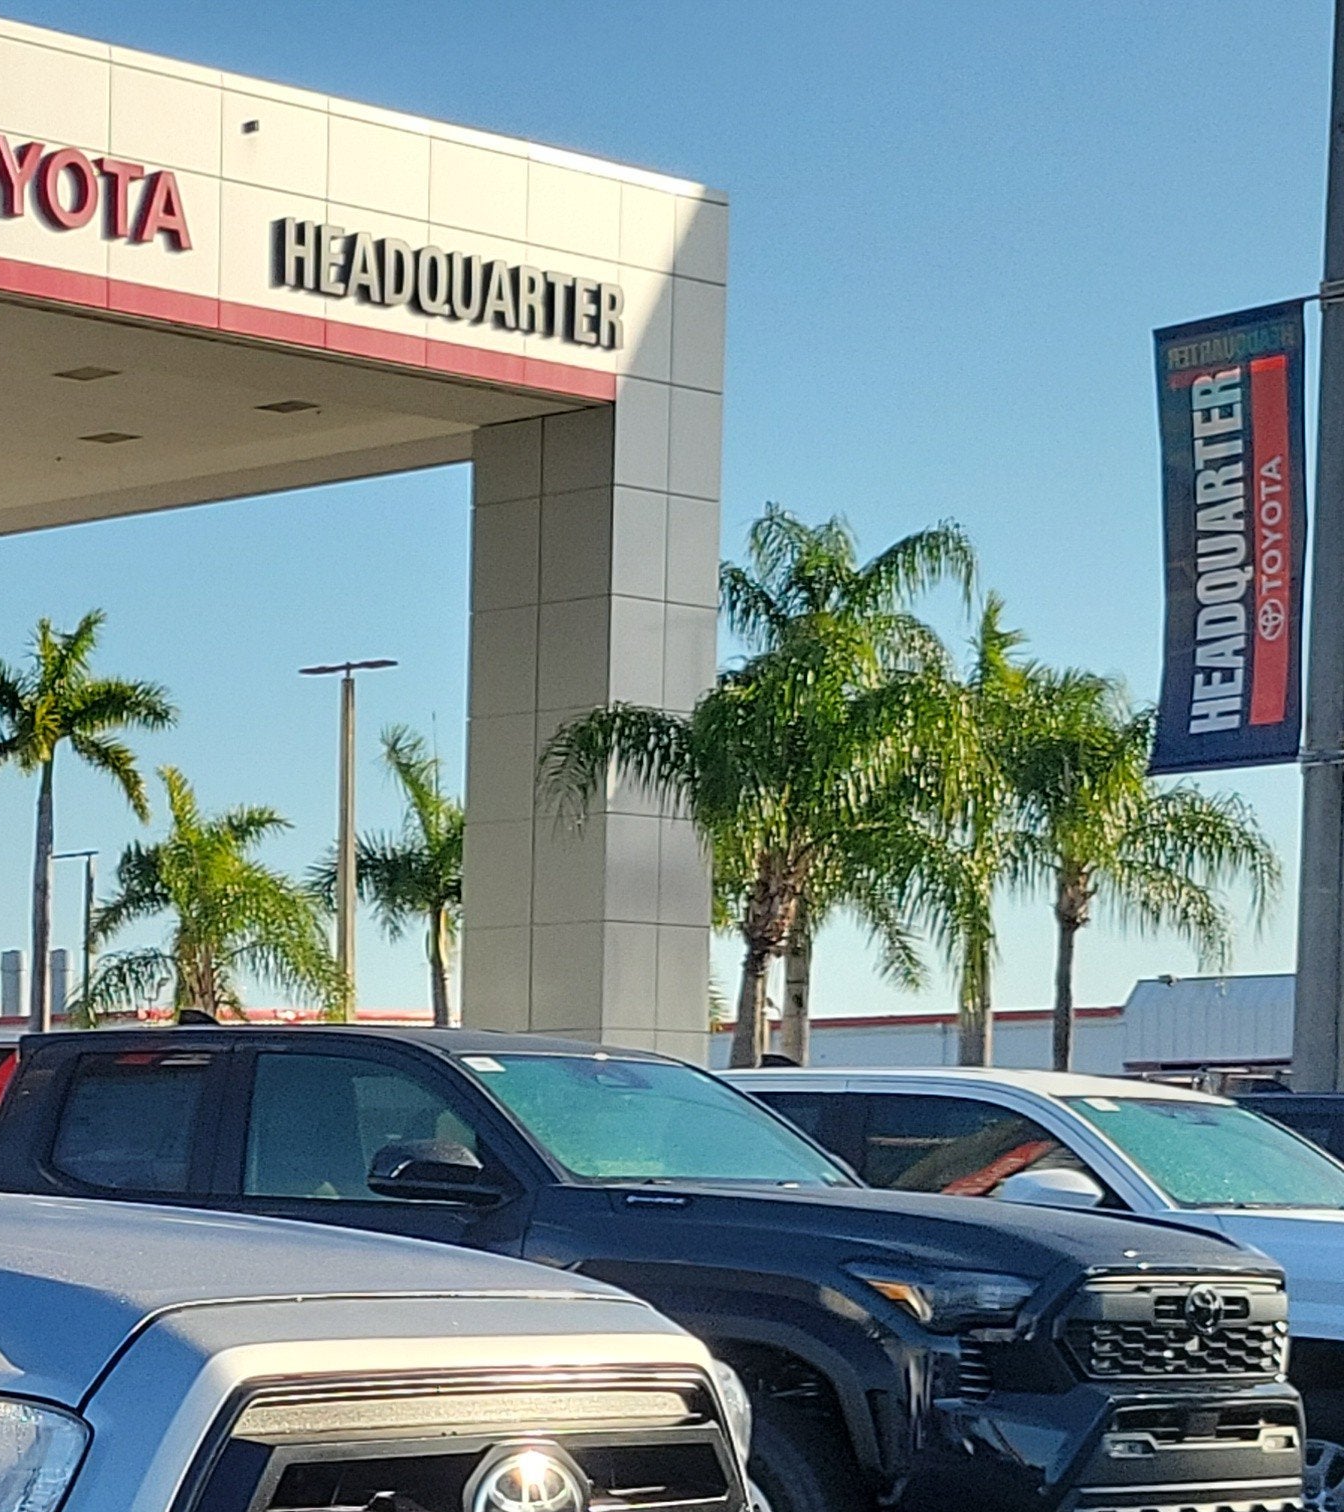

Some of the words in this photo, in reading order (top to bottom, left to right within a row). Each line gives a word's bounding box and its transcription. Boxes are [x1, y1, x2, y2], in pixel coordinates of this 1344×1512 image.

[272, 215, 626, 350] HEADQUARTER
[1187, 364, 1254, 736] HEADQUARTER
[1260, 455, 1283, 593] TOYOTA
